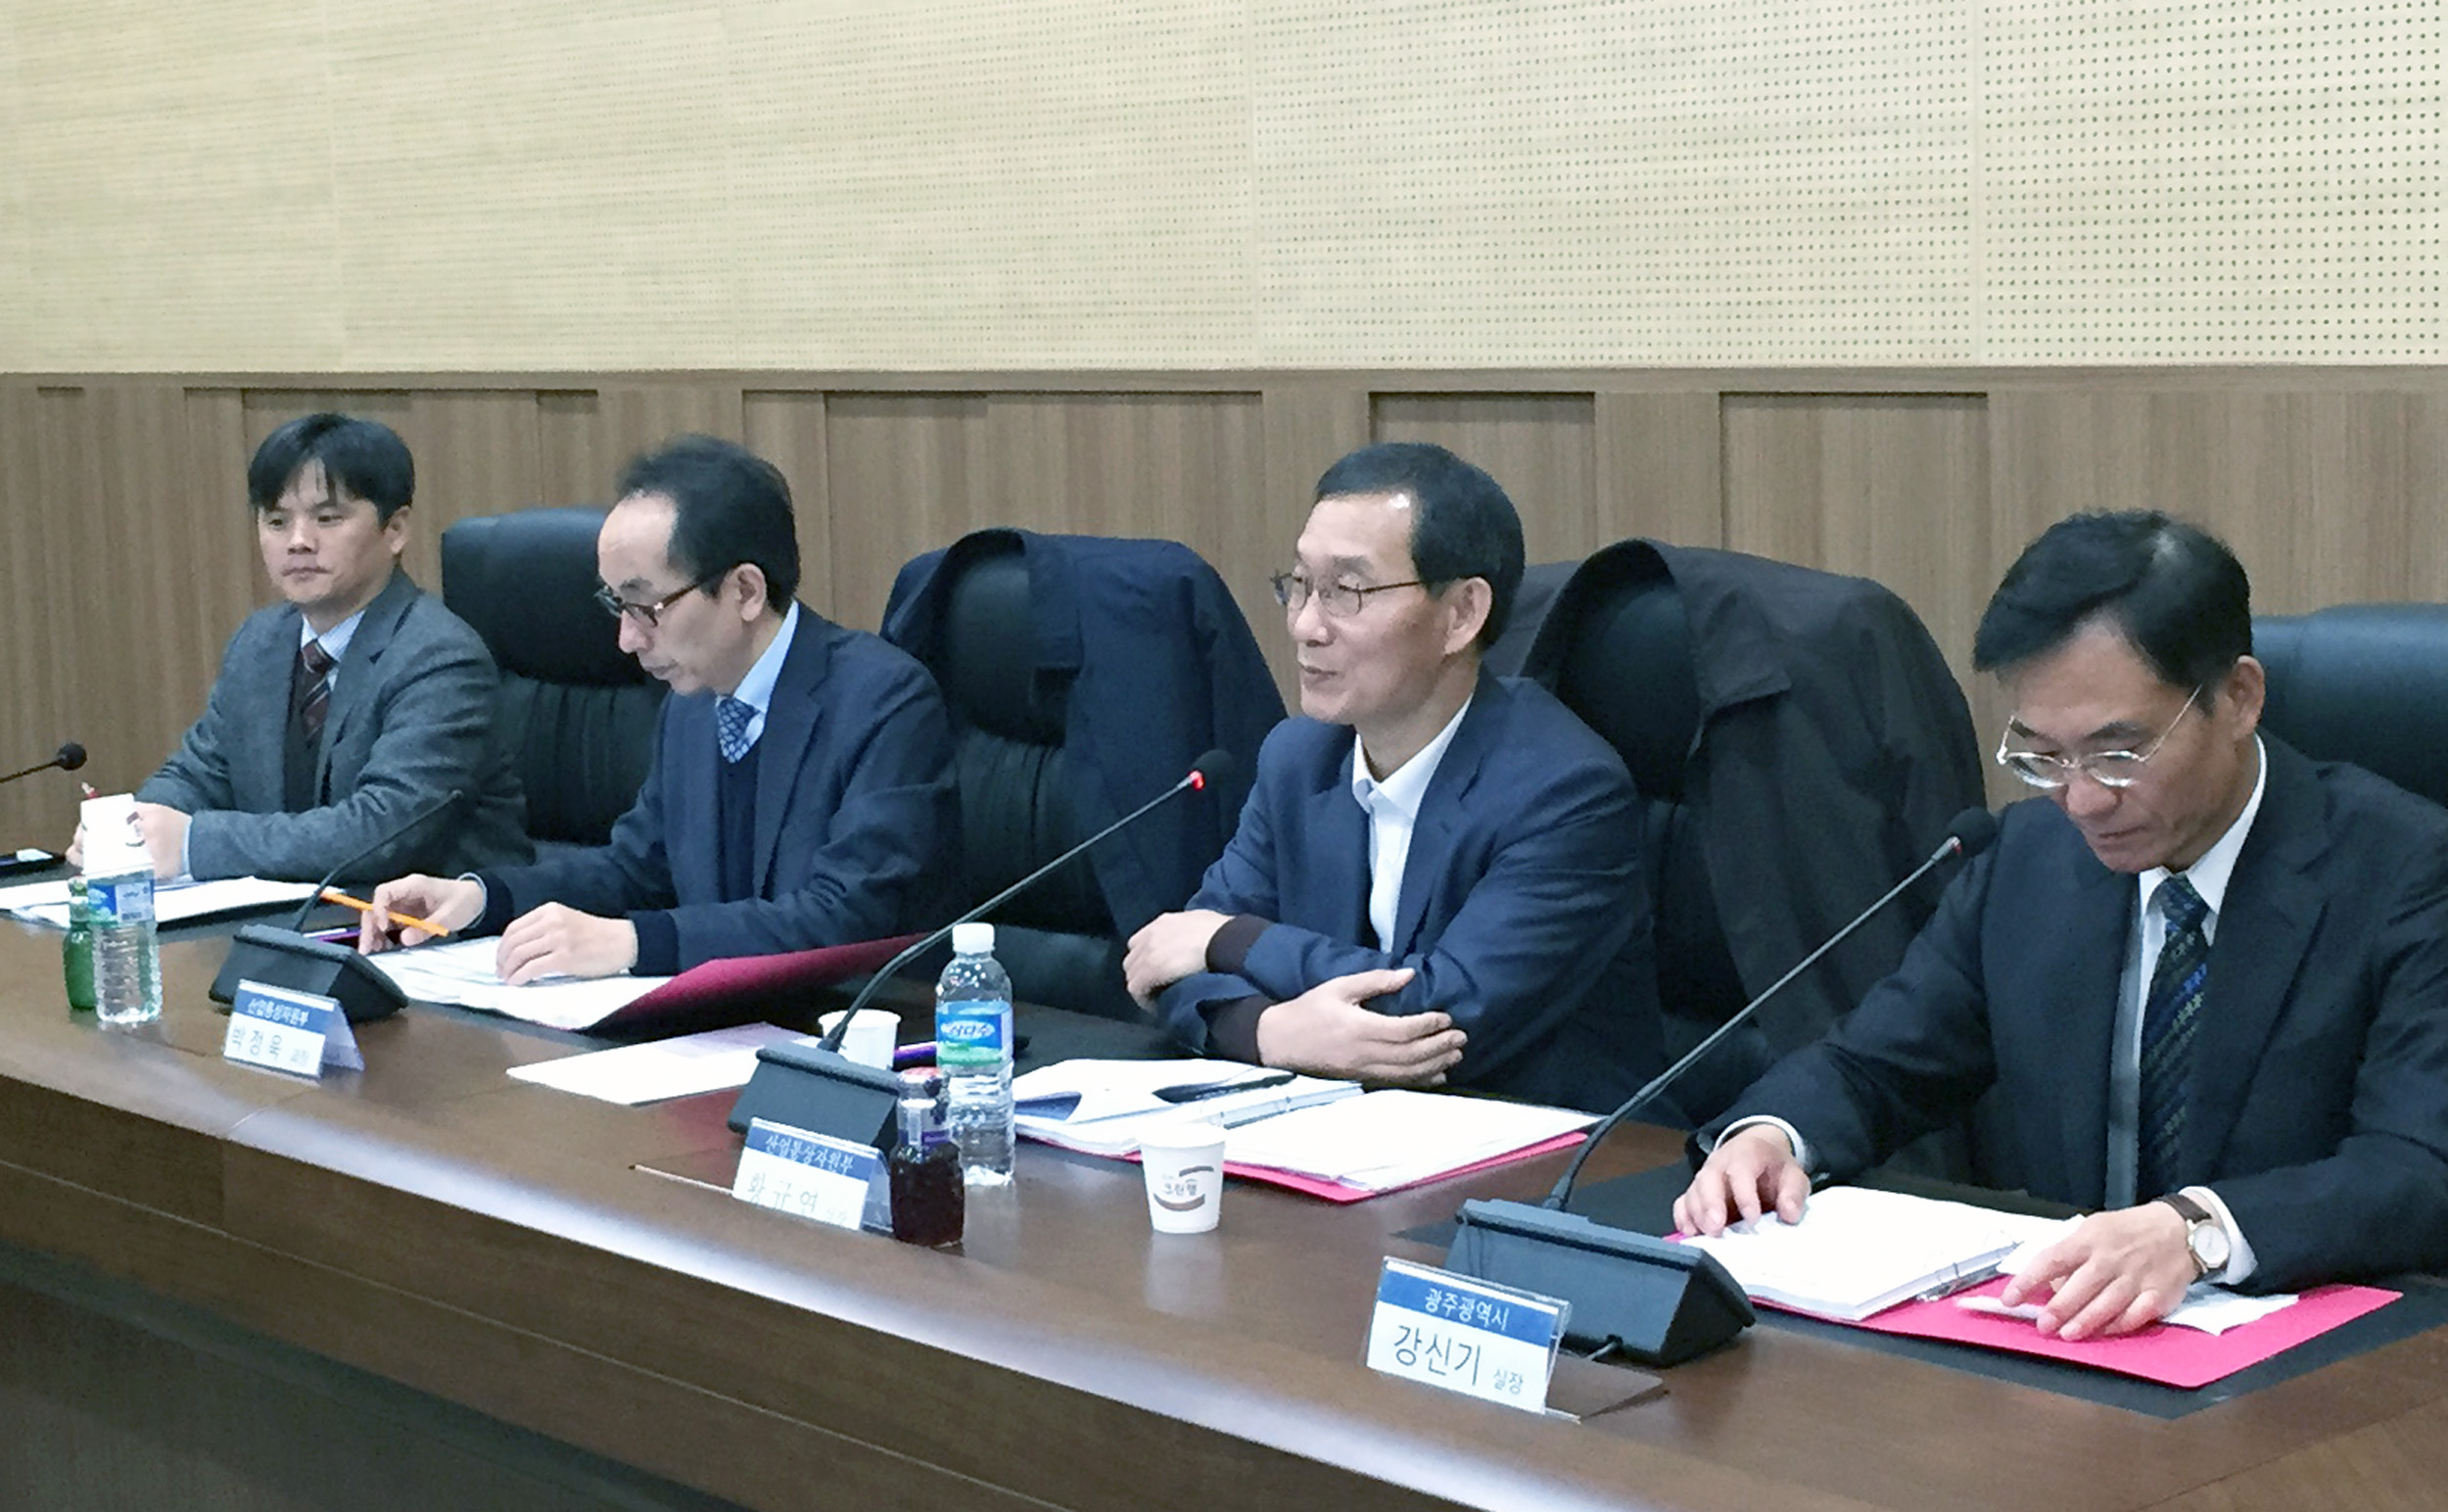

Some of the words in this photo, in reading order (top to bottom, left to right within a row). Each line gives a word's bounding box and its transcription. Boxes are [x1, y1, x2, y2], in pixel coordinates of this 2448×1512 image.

[765, 1133, 854, 1176] 산업통상자원부
[1424, 1287, 1510, 1332] 광주광역시
[1392, 1324, 1482, 1387] 강신기
[1492, 1367, 1525, 1395] 실장
